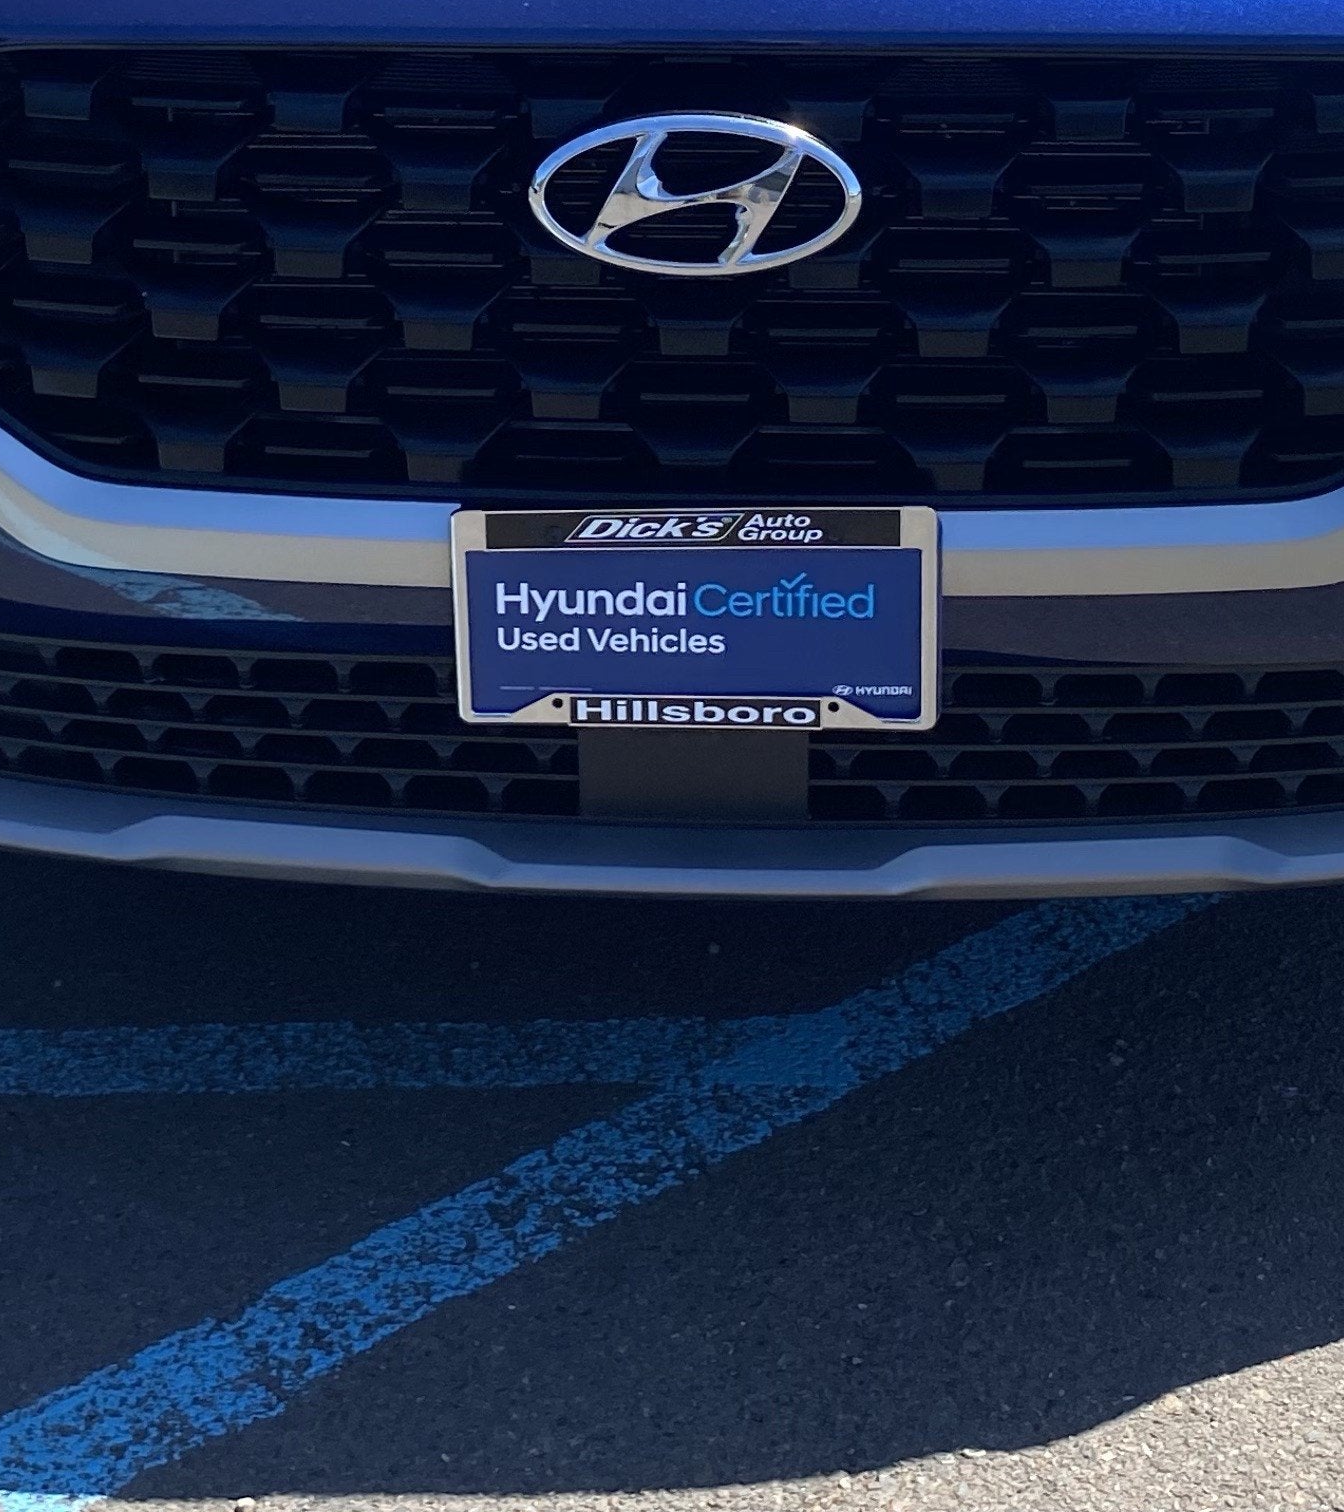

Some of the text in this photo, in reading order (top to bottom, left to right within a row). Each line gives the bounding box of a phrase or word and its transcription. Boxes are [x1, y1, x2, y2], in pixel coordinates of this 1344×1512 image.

[578, 517, 725, 539] Dick's
[744, 513, 811, 529] Auto
[737, 527, 824, 543] Group
[496, 573, 875, 622] Hyundai Certified
[497, 626, 726, 654] Used Vehicles
[855, 685, 913, 696] HYUNDAI
[576, 699, 817, 724] Hillsboro
